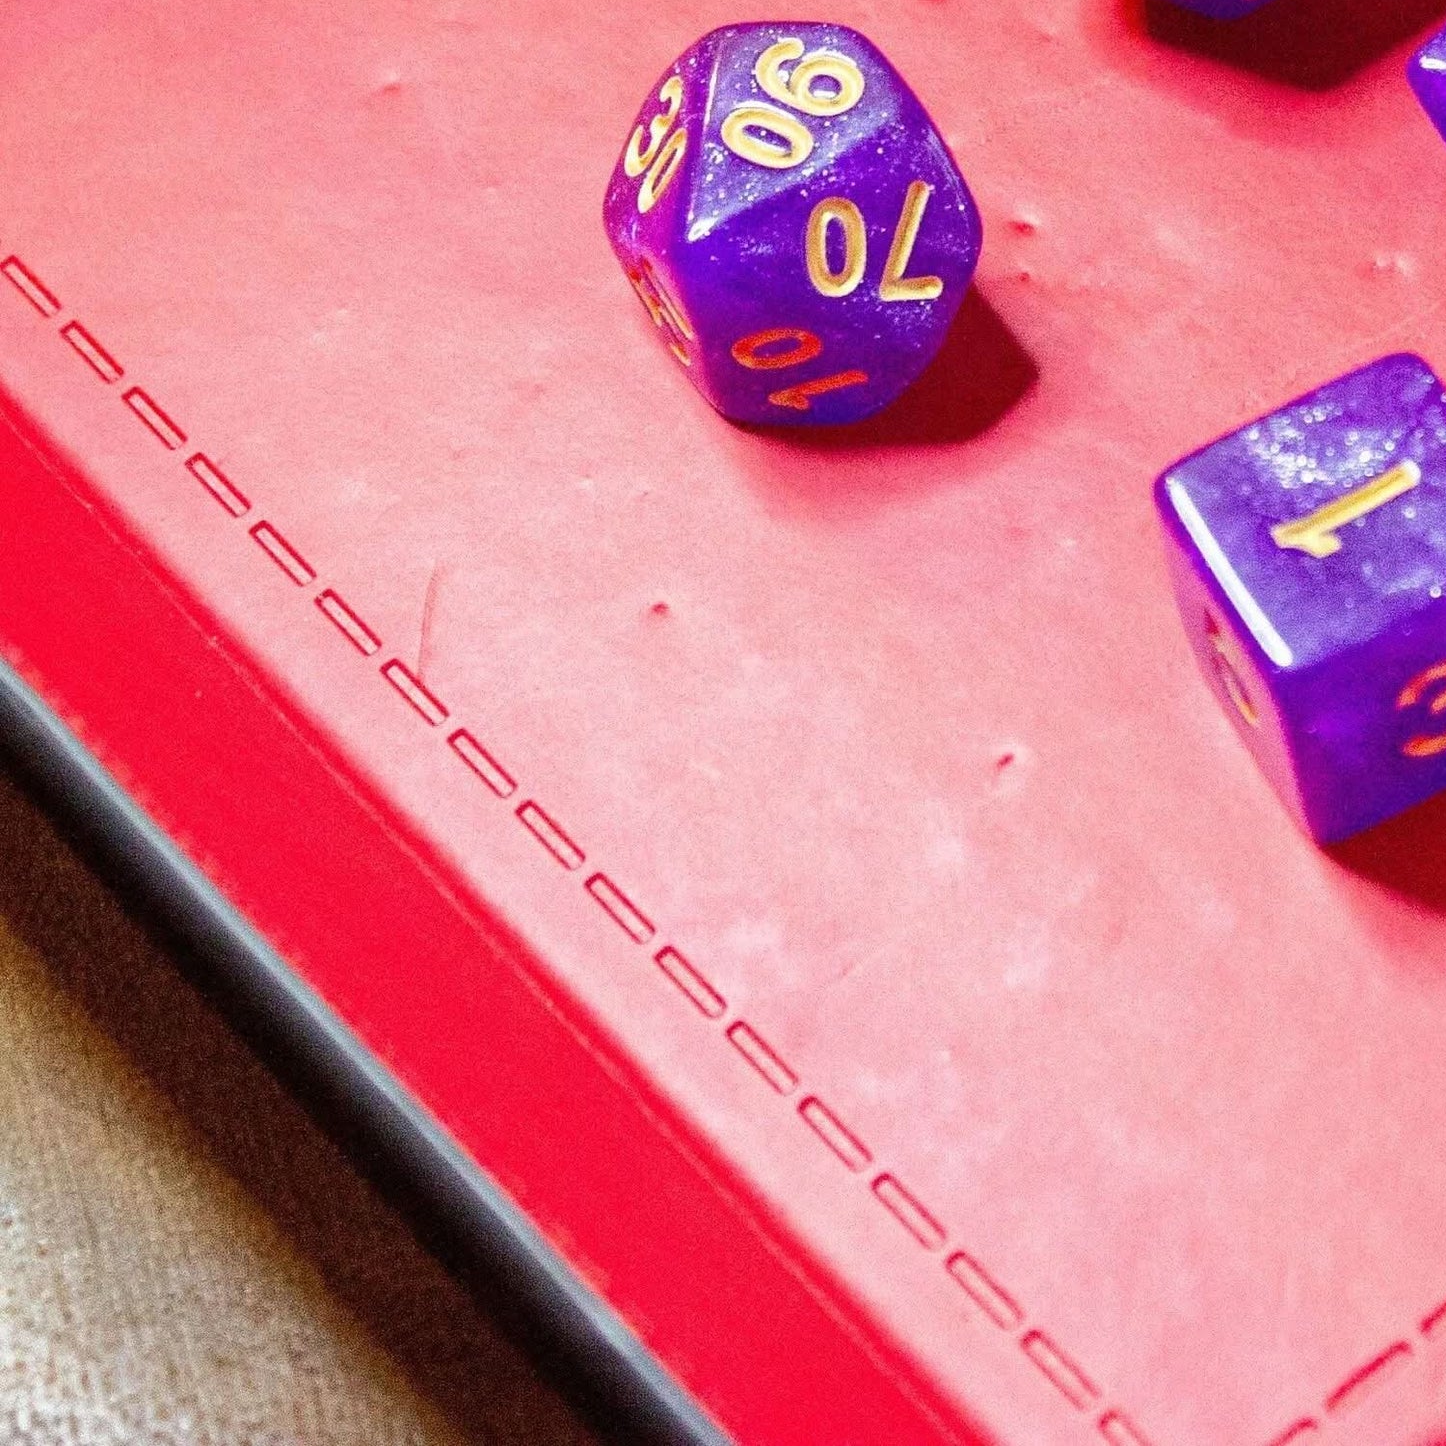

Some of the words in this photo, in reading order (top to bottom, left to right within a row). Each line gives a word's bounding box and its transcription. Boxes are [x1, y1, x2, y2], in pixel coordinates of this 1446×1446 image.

[624, 74, 687, 214] 30
[805, 180, 944, 302] 70
[731, 328, 869, 410] 10
[1270, 458, 1422, 559] 1
